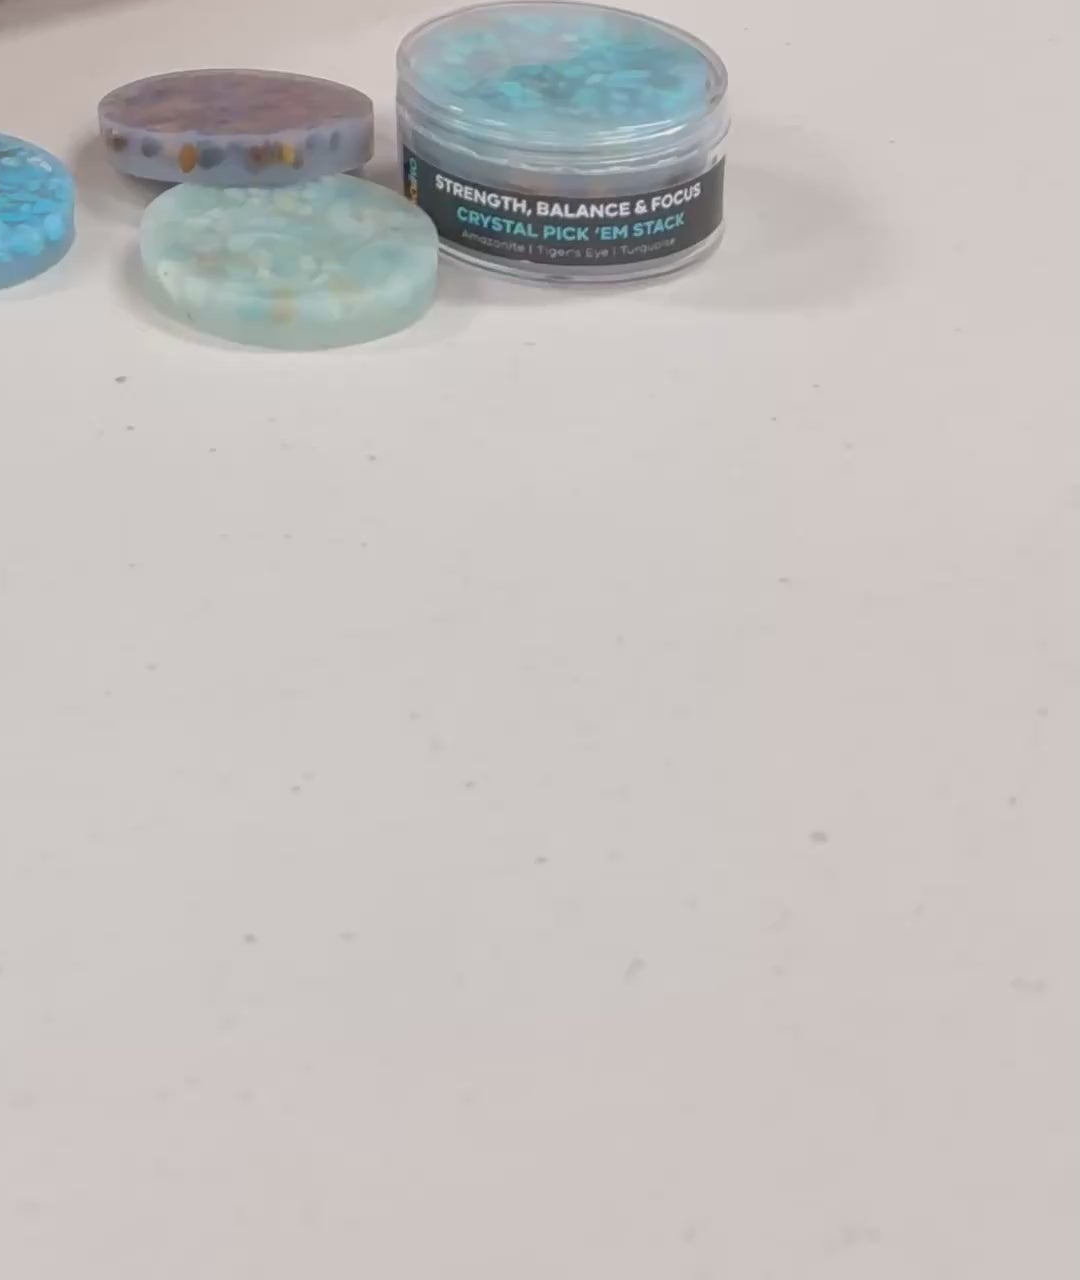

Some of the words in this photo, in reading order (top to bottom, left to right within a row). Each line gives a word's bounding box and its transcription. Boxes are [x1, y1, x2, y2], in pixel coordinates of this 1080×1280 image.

[435, 173, 532, 217] STRENGTH,
[536, 201, 630, 218] BALANCE
[635, 199, 648, 214] &
[651, 182, 702, 210] FOCUS
[456, 206, 538, 238] CRYSTAL
[543, 225, 589, 241] PICK
[633, 212, 685, 237] STACK
[585, 247, 609, 259] Eye
